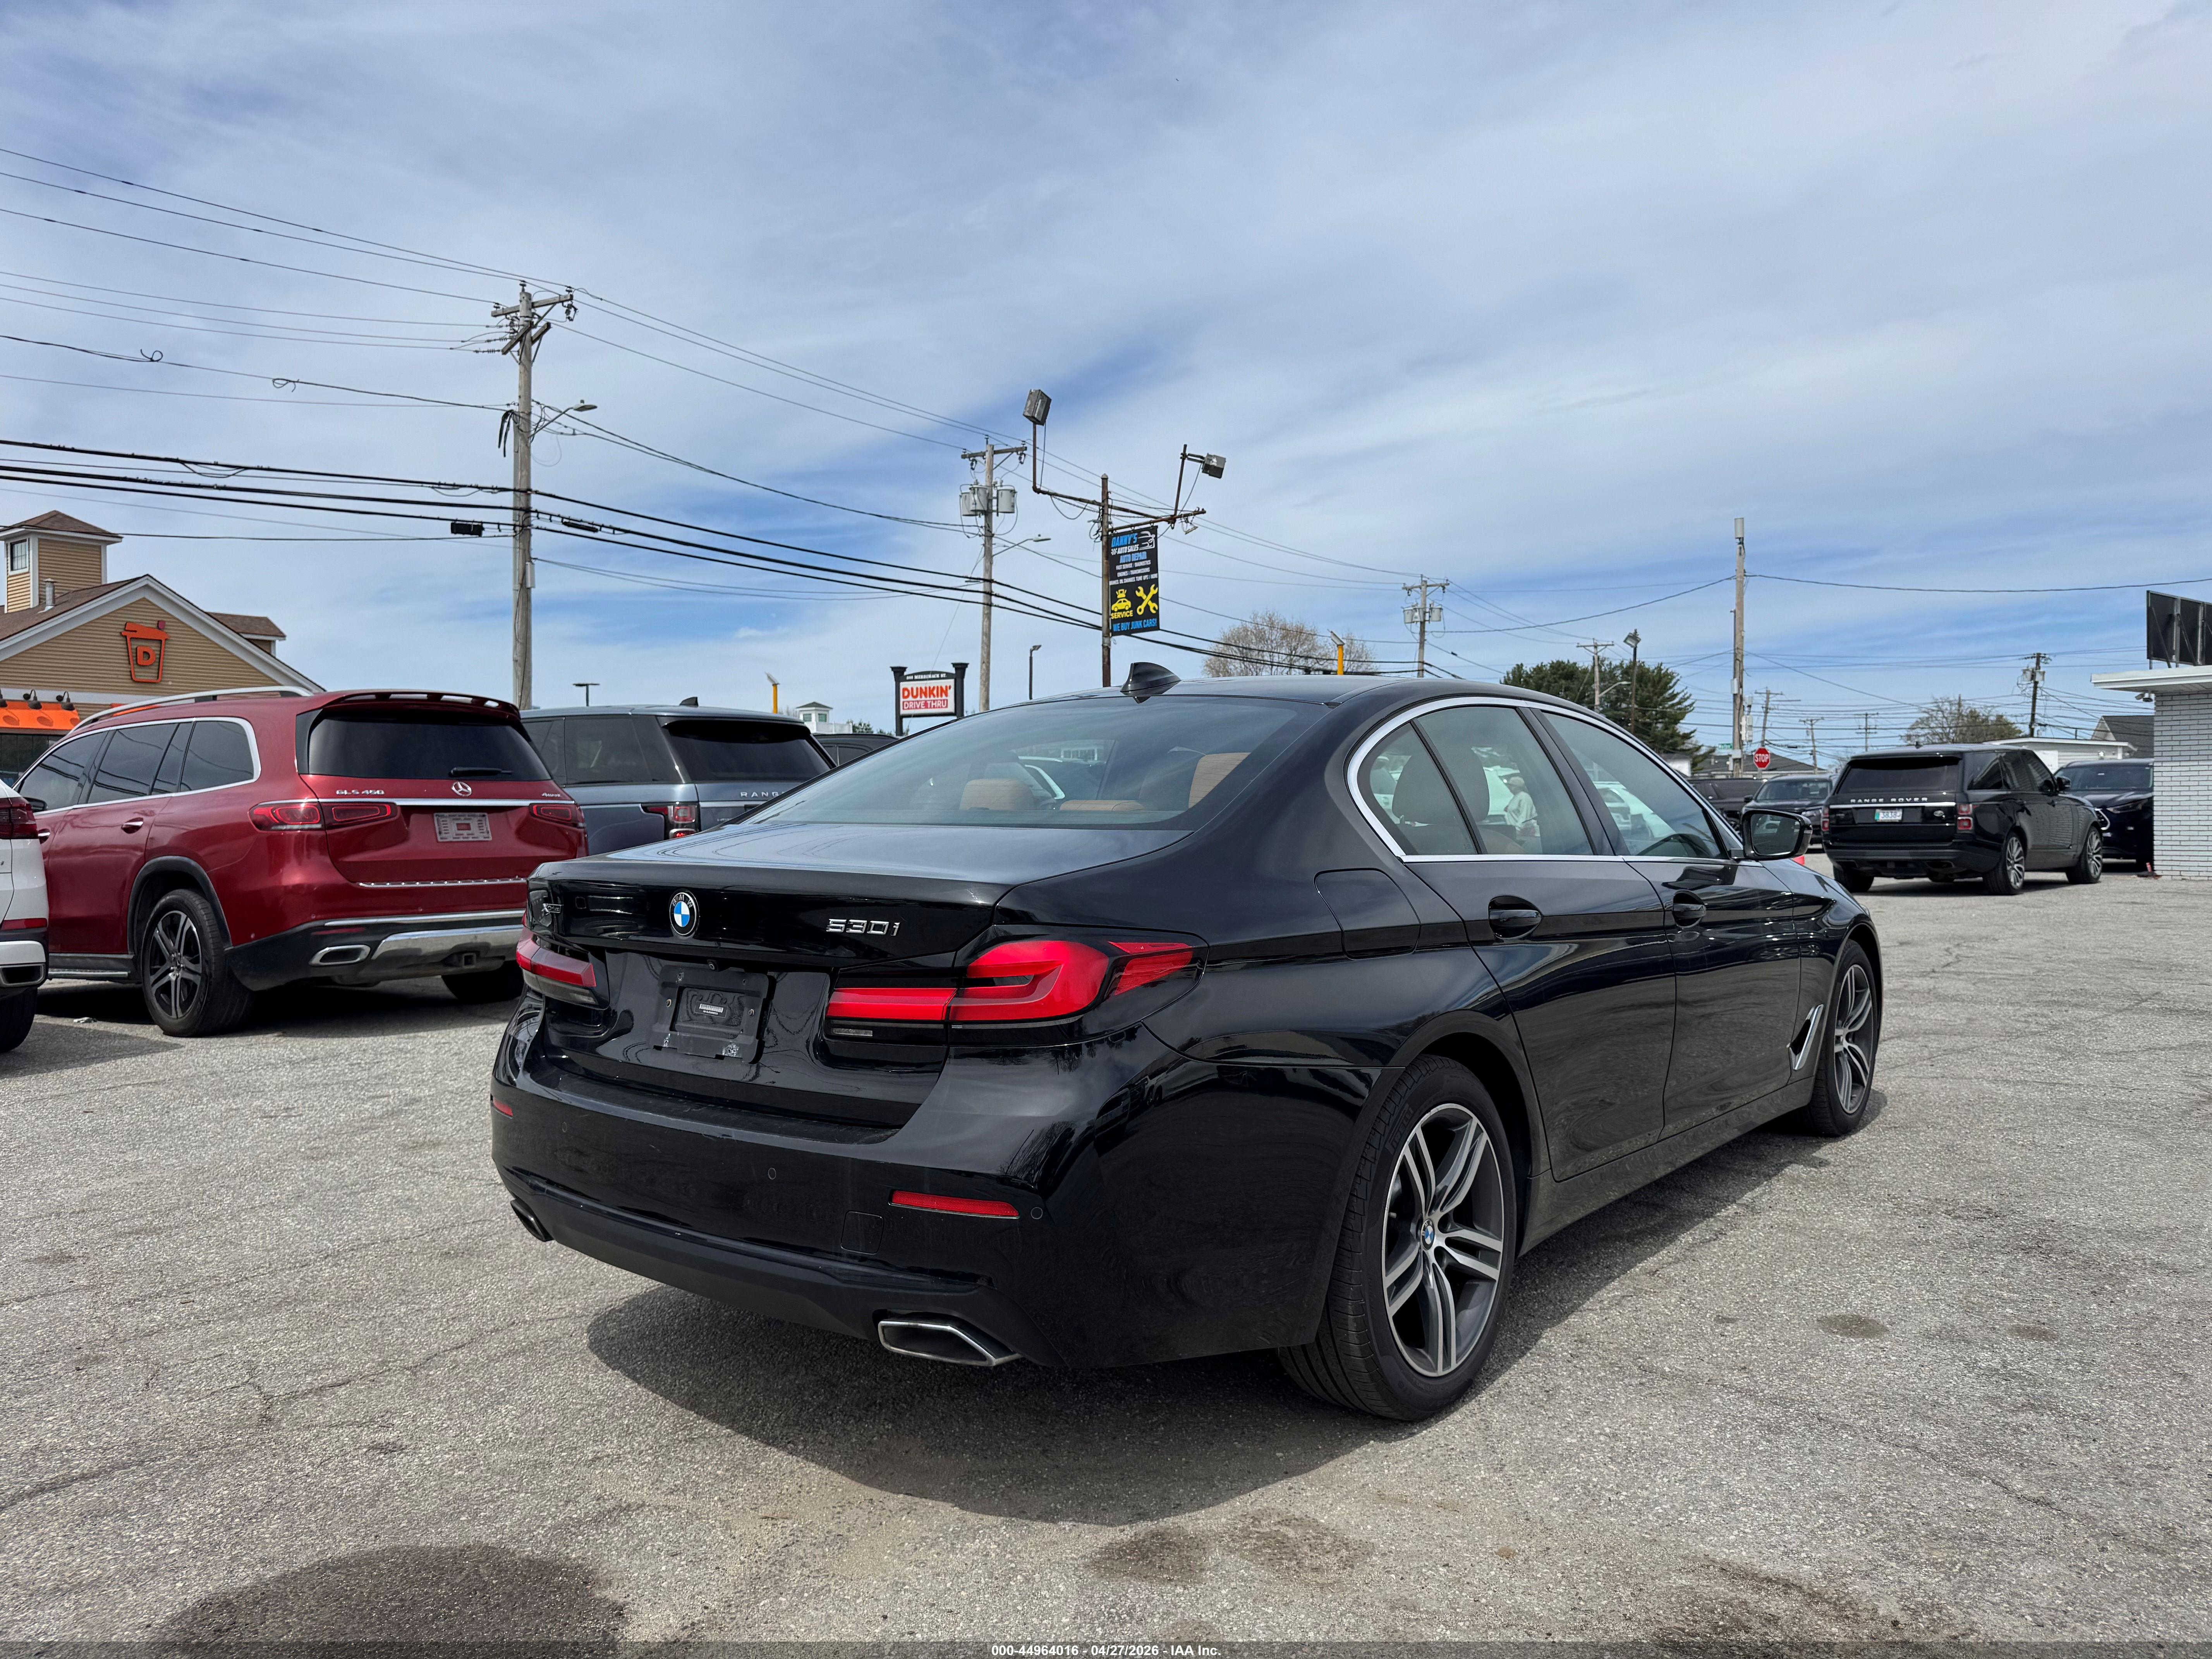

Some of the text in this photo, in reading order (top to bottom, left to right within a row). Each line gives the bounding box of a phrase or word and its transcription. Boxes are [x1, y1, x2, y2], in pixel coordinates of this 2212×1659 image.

[1111, 533, 1138, 547] DANNY'S
[1117, 544, 1139, 555] AUTO SALES
[1111, 610, 1133, 619] SERVICE
[1113, 618, 1157, 632] WE BUY JUNK CARS!
[137, 646, 156, 665] D
[902, 685, 951, 699] DUNKIN'
[904, 700, 947, 709] DRIVE THRU
[1755, 753, 1769, 763] STOP
[672, 894, 693, 908] BMW
[826, 919, 900, 936] 530i
